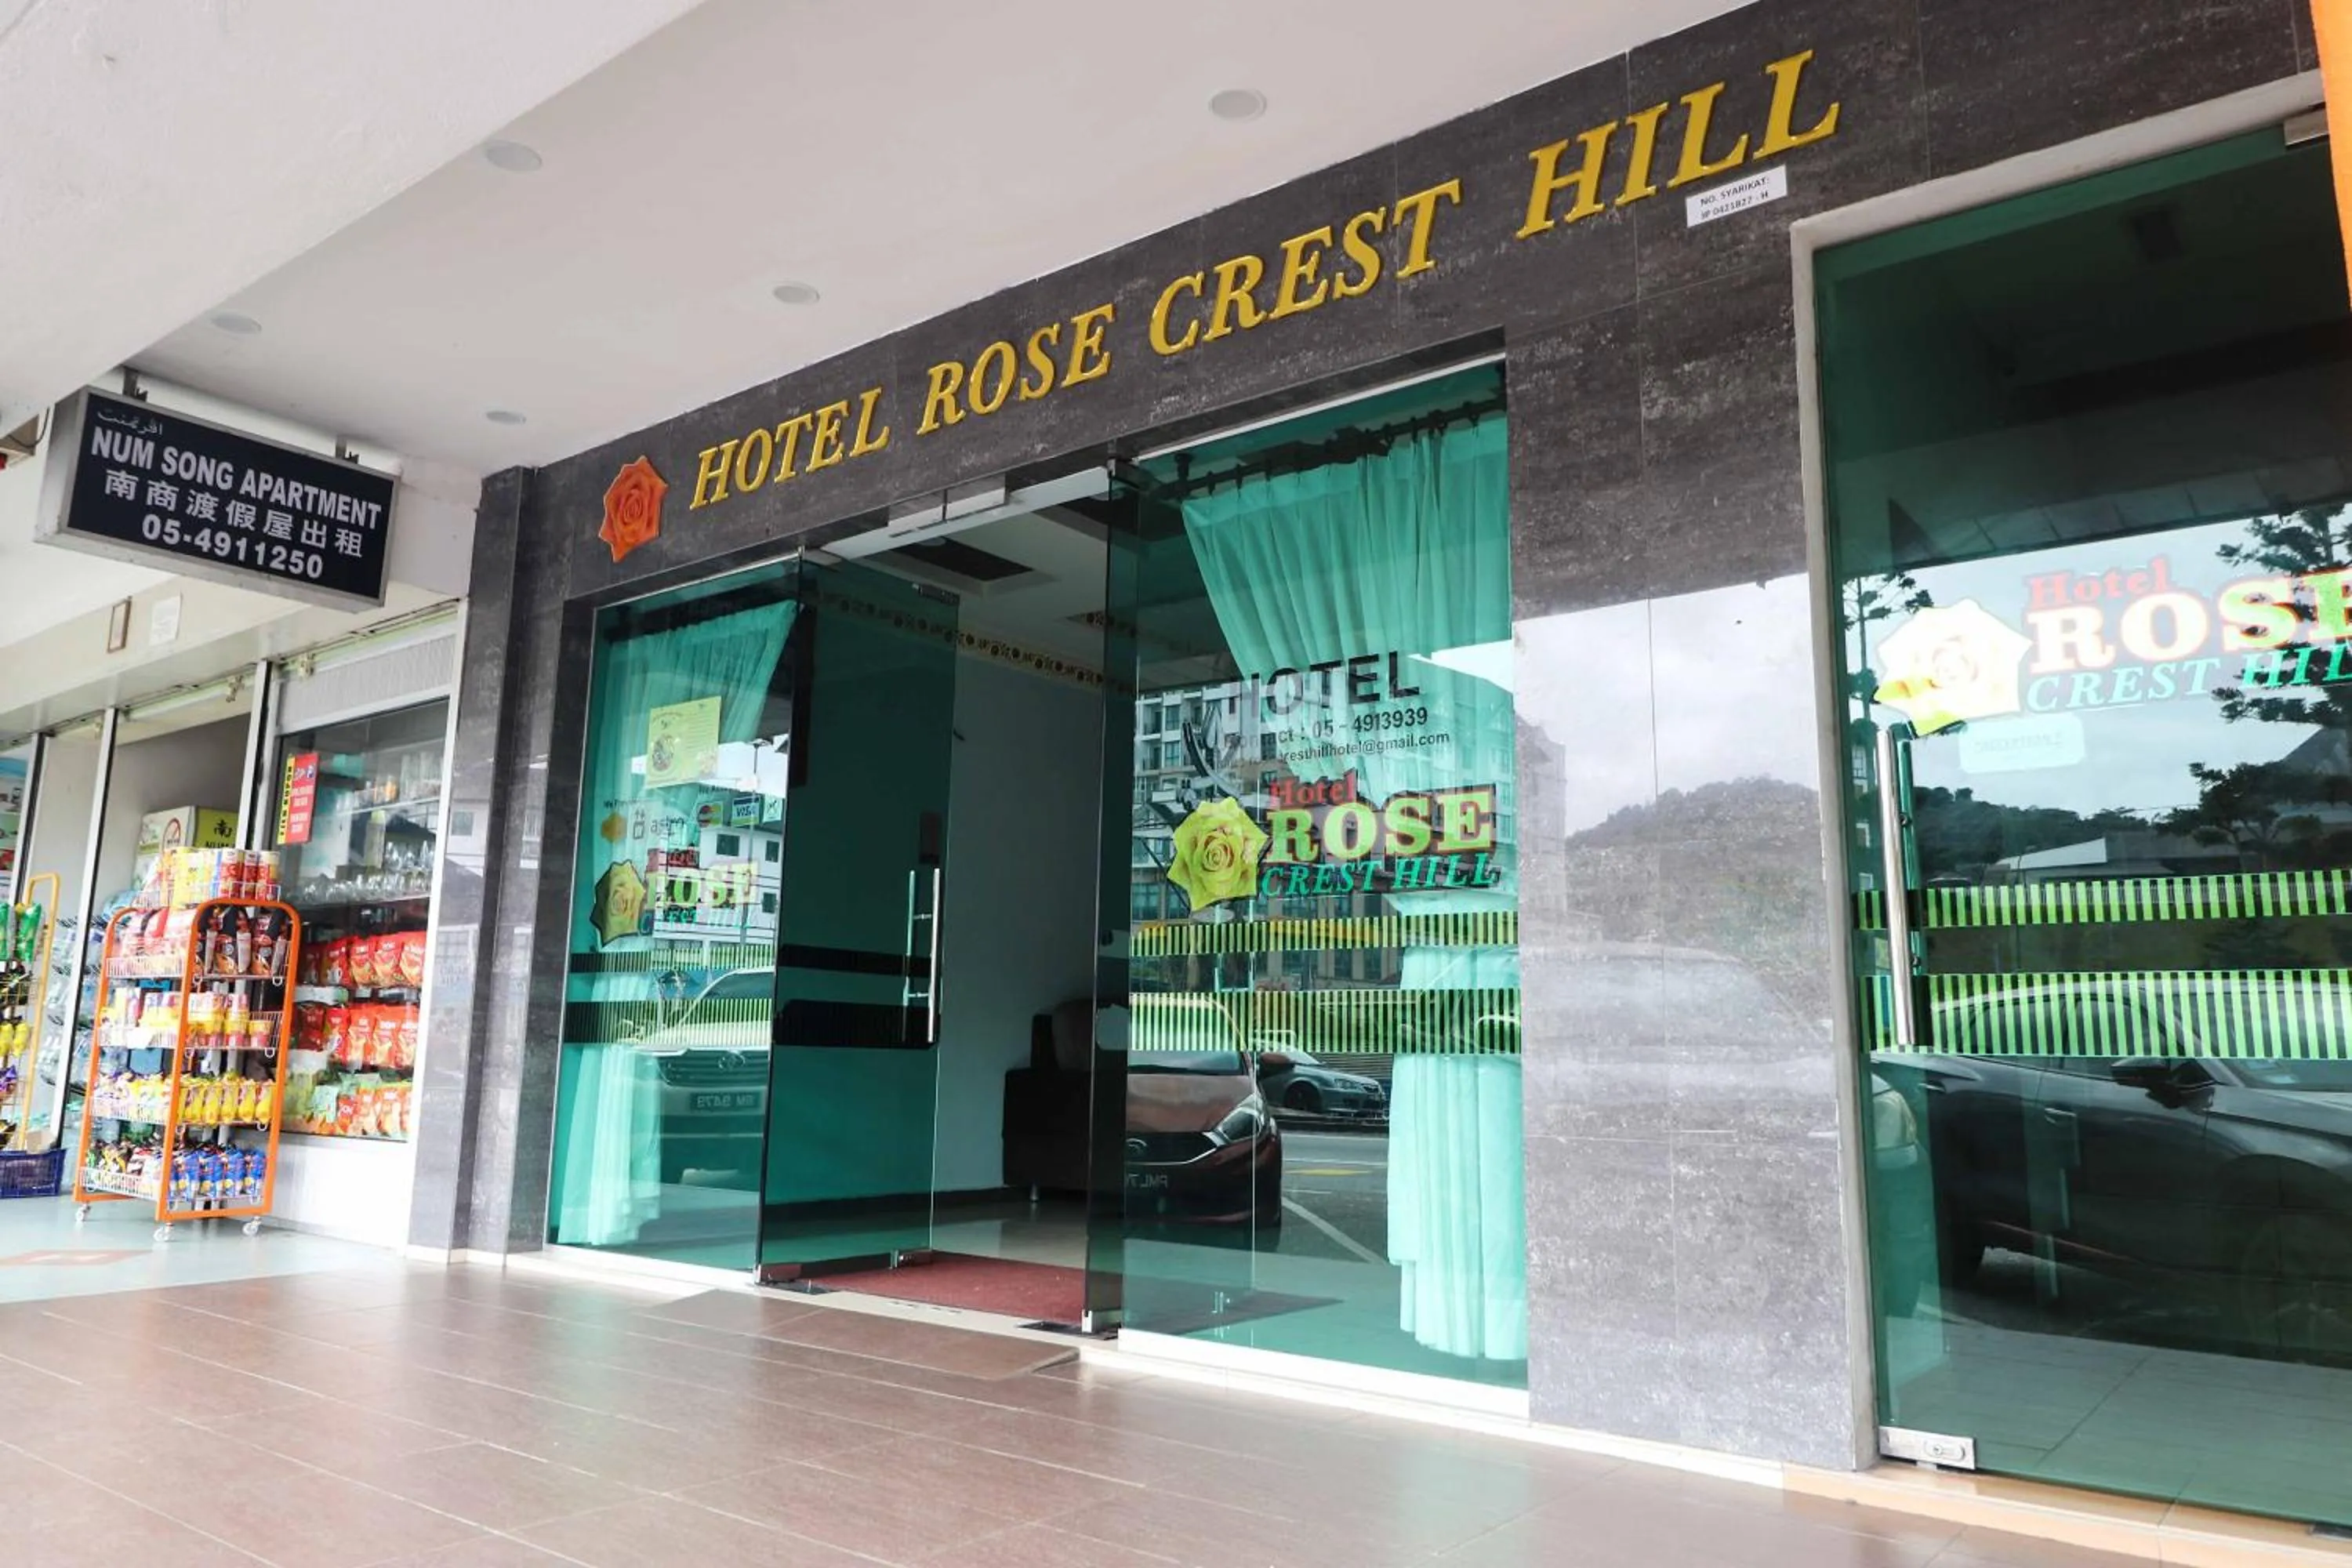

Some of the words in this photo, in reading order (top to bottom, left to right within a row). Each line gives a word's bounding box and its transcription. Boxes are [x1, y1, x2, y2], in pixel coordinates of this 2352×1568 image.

[690, 387, 890, 510] HOTEL
[916, 303, 1114, 435] ROSE
[1149, 179, 1462, 356] CREST
[1515, 49, 1841, 240] HILL
[91, 426, 155, 470] NUM
[161, 446, 233, 489] SONG
[239, 468, 381, 529] APARTMENT
[105, 469, 363, 557] 南商渡假屋出租
[142, 515, 324, 579] 05-4911250
[2028, 554, 2171, 607] Hotel
[2026, 568, 2352, 674] ROSE
[1229, 651, 1420, 717] HOTEL
[2027, 657, 2220, 713] CREST
[1354, 706, 1428, 733] 4913939
[1269, 770, 1357, 805] Hotel
[1265, 789, 1492, 863] ROSE
[1261, 859, 1383, 897] CREST
[1392, 852, 1501, 890] HILL
